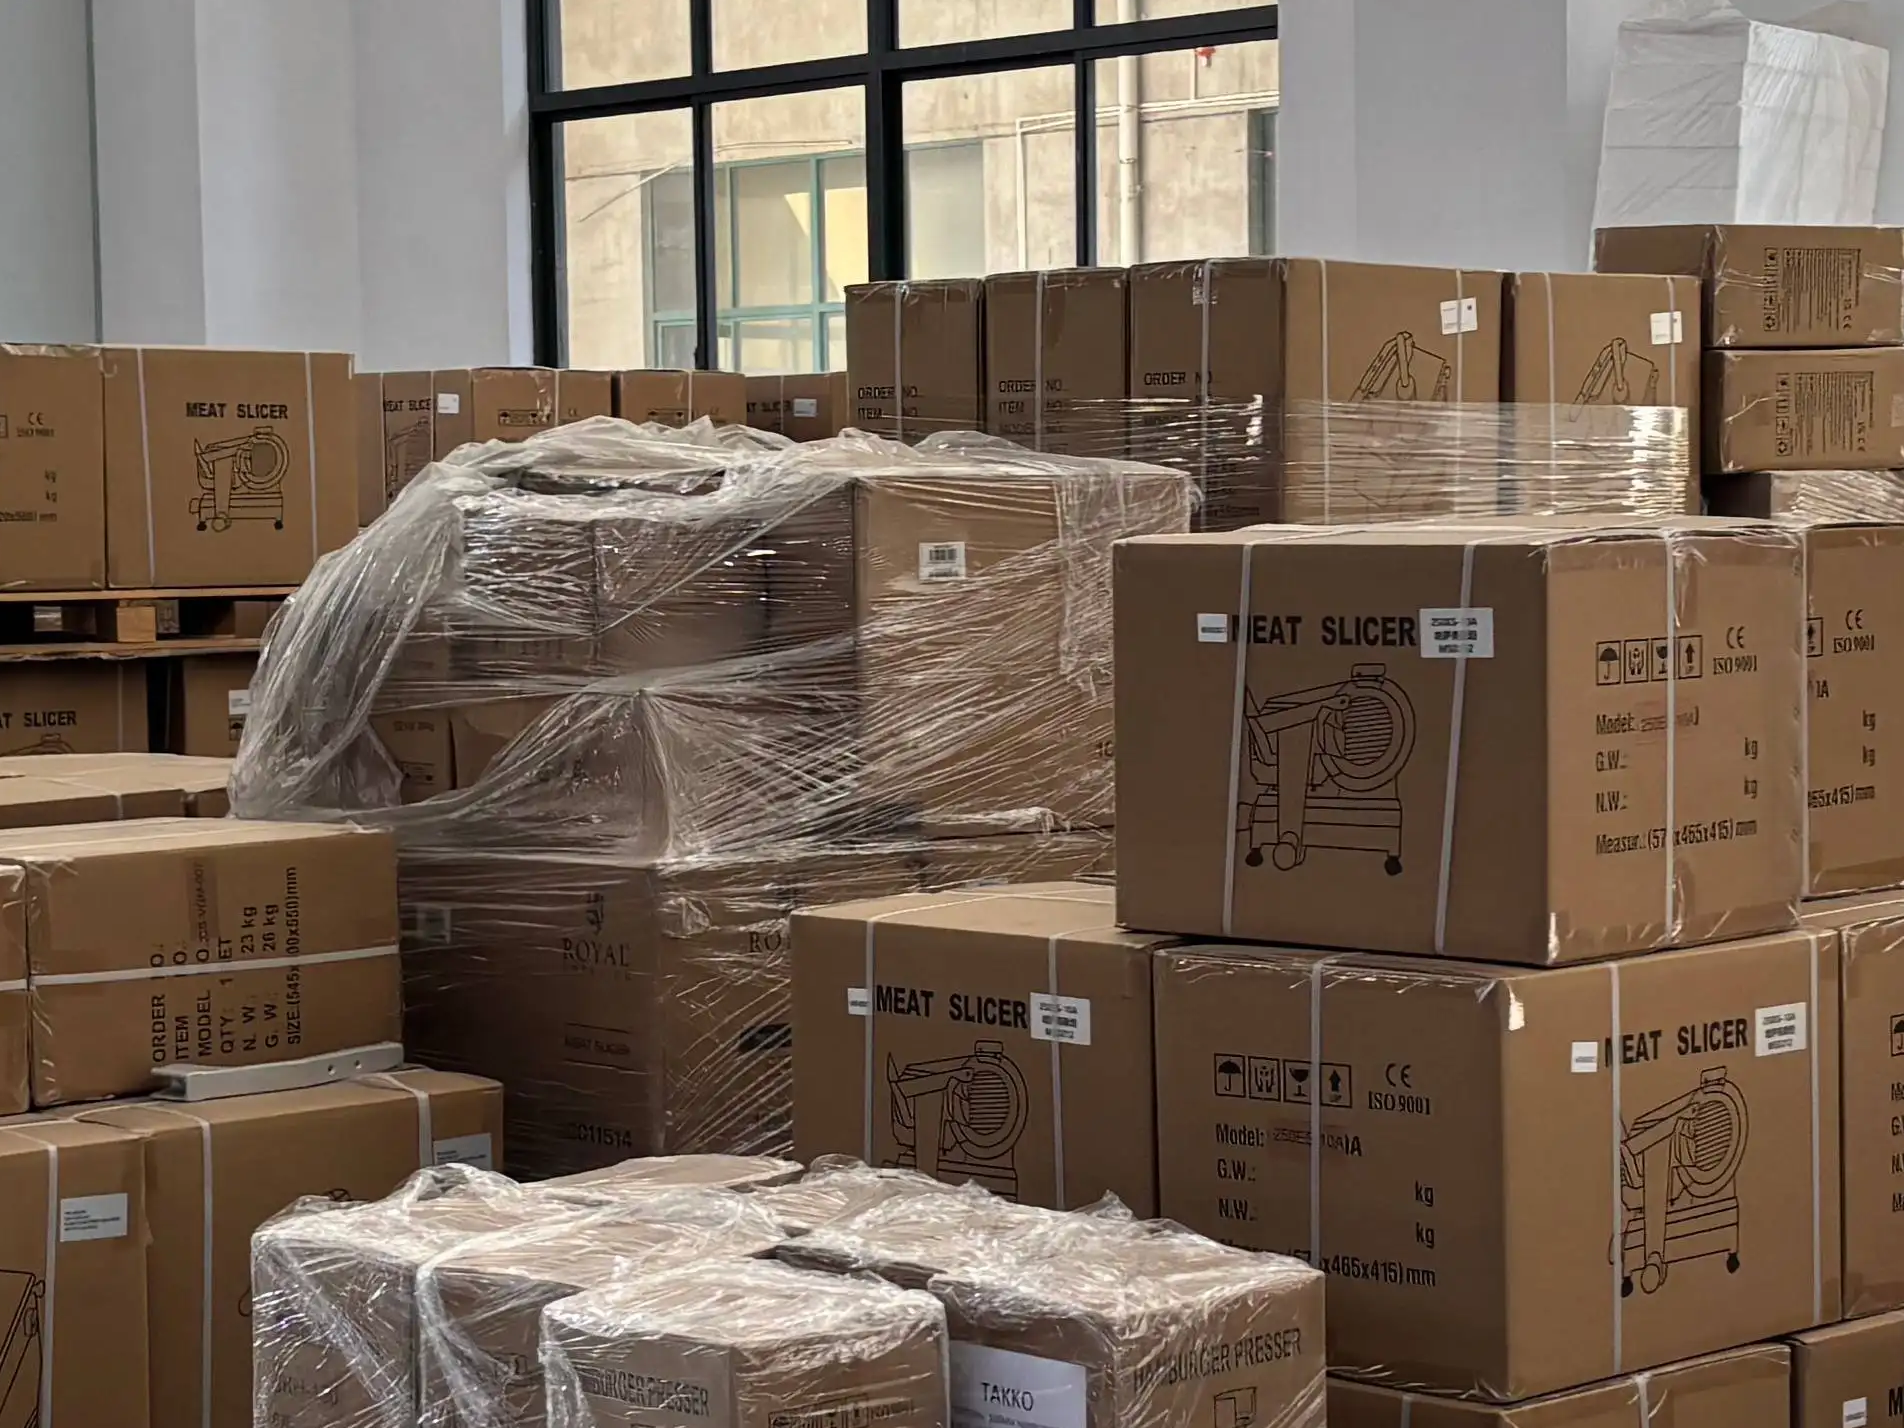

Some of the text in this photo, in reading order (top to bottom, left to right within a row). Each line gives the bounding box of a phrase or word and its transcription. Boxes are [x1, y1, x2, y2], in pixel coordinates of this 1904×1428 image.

[1144, 372, 1186, 385] ORDER
[186, 402, 288, 420] MEAT SLICER
[1321, 616, 1416, 646] SLICER
[24, 711, 77, 728] SLICER
[1863, 710, 1876, 731] kg
[1745, 737, 1758, 759] kg
[1863, 746, 1876, 767] kg
[1745, 776, 1758, 798] kg
[243, 907, 257, 928] kg
[265, 904, 279, 926] kg
[241, 934, 255, 954] 23
[262, 932, 277, 952] 26
[562, 938, 629, 967] ROYAL
[220, 977, 234, 986] 1
[876, 985, 934, 1018] MEAT
[949, 993, 1028, 1029] SLICER
[152, 994, 166, 1062] ORDER
[197, 990, 212, 1057] MODEL
[175, 1015, 189, 1060] ITEM
[1677, 1018, 1748, 1055] SLICER
[1385, 1063, 1412, 1088] CE
[1216, 1124, 1264, 1148] Model:
[1217, 1158, 1434, 1207] G.W.: kg
[1218, 1198, 1435, 1249] N.W.: kg
[1406, 1268, 1436, 1287] mm
[1234, 1327, 1302, 1369] PRESSER
[981, 1382, 1034, 1411] TAKKO
